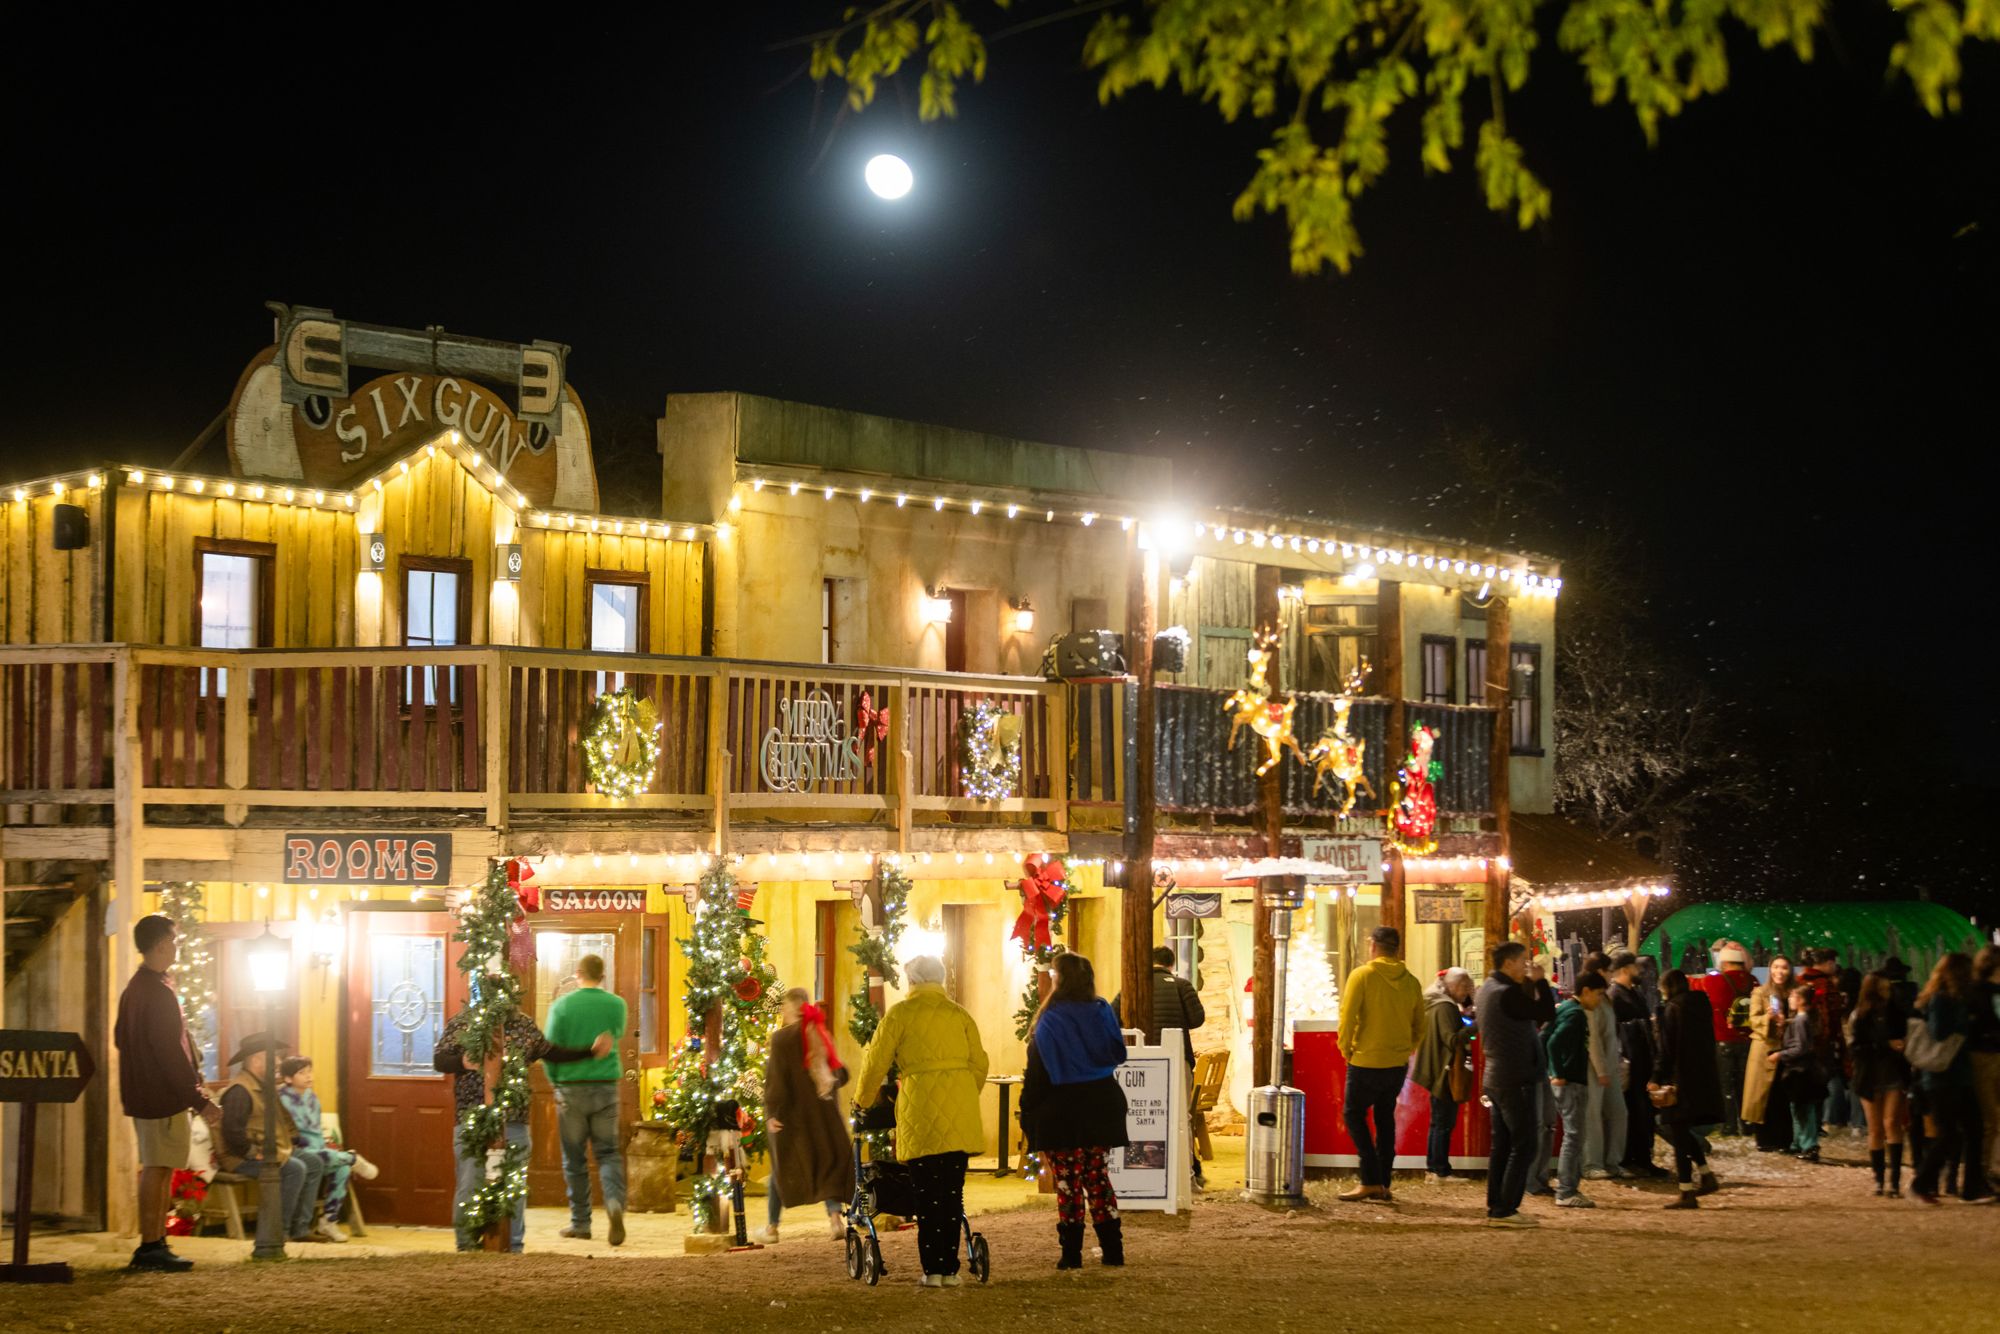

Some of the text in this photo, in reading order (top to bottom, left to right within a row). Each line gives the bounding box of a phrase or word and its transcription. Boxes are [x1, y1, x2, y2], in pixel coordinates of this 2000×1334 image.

[780, 688, 846, 743] MERRY
[760, 727, 863, 793] CHRISTMAS
[287, 839, 438, 880] ROOMS
[550, 891, 641, 910] SALOON
[0, 1050, 80, 1078] SANTA
[1125, 1070, 1145, 1088] GUN
[1149, 1108, 1165, 1116] WITH
[1150, 1099, 1162, 1107] AND
[1136, 1117, 1155, 1125] SANTA
